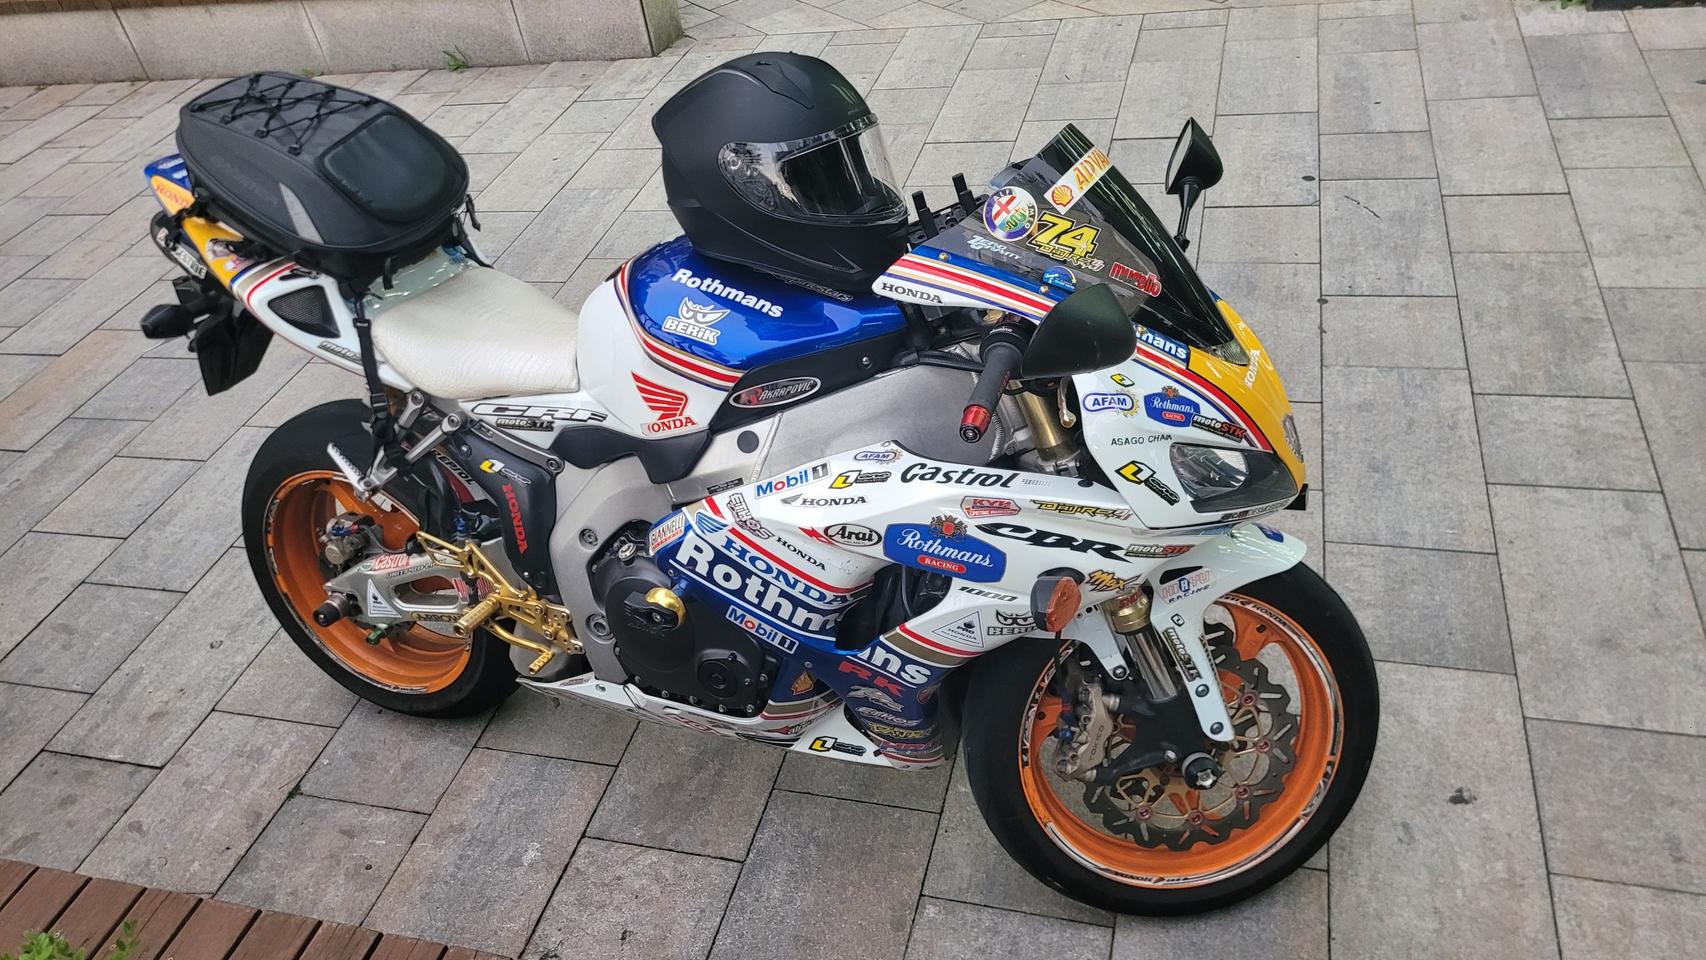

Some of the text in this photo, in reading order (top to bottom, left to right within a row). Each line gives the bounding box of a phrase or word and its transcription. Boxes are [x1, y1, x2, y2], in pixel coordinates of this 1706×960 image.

[1030, 211, 1100, 257] 74
[672, 267, 784, 318] Rothmans
[881, 281, 943, 304] HONDA
[1092, 396, 1128, 408] AFAM
[1151, 396, 1195, 413] Rothmans
[1111, 434, 1173, 446] ASAGO CHAIN
[757, 470, 809, 497] Mobil
[812, 464, 829, 481] 1
[900, 463, 1020, 488] Castrol
[801, 496, 868, 507] HONDA
[502, 484, 528, 554] HONDA
[836, 525, 875, 542] Arai
[975, 522, 1133, 563] CBR
[776, 536, 826, 571] HONDA
[897, 529, 994, 568] Rothmans
[721, 535, 853, 604] HONDA
[925, 557, 959, 571] RACING
[958, 586, 1018, 602] 1000
[728, 607, 778, 643] Mobil
[1253, 604, 1288, 627] HONDA
[948, 628, 977, 640] HONDA
[957, 625, 975, 635] PRO
[986, 626, 1036, 636] BERI
[838, 661, 904, 697] RK
